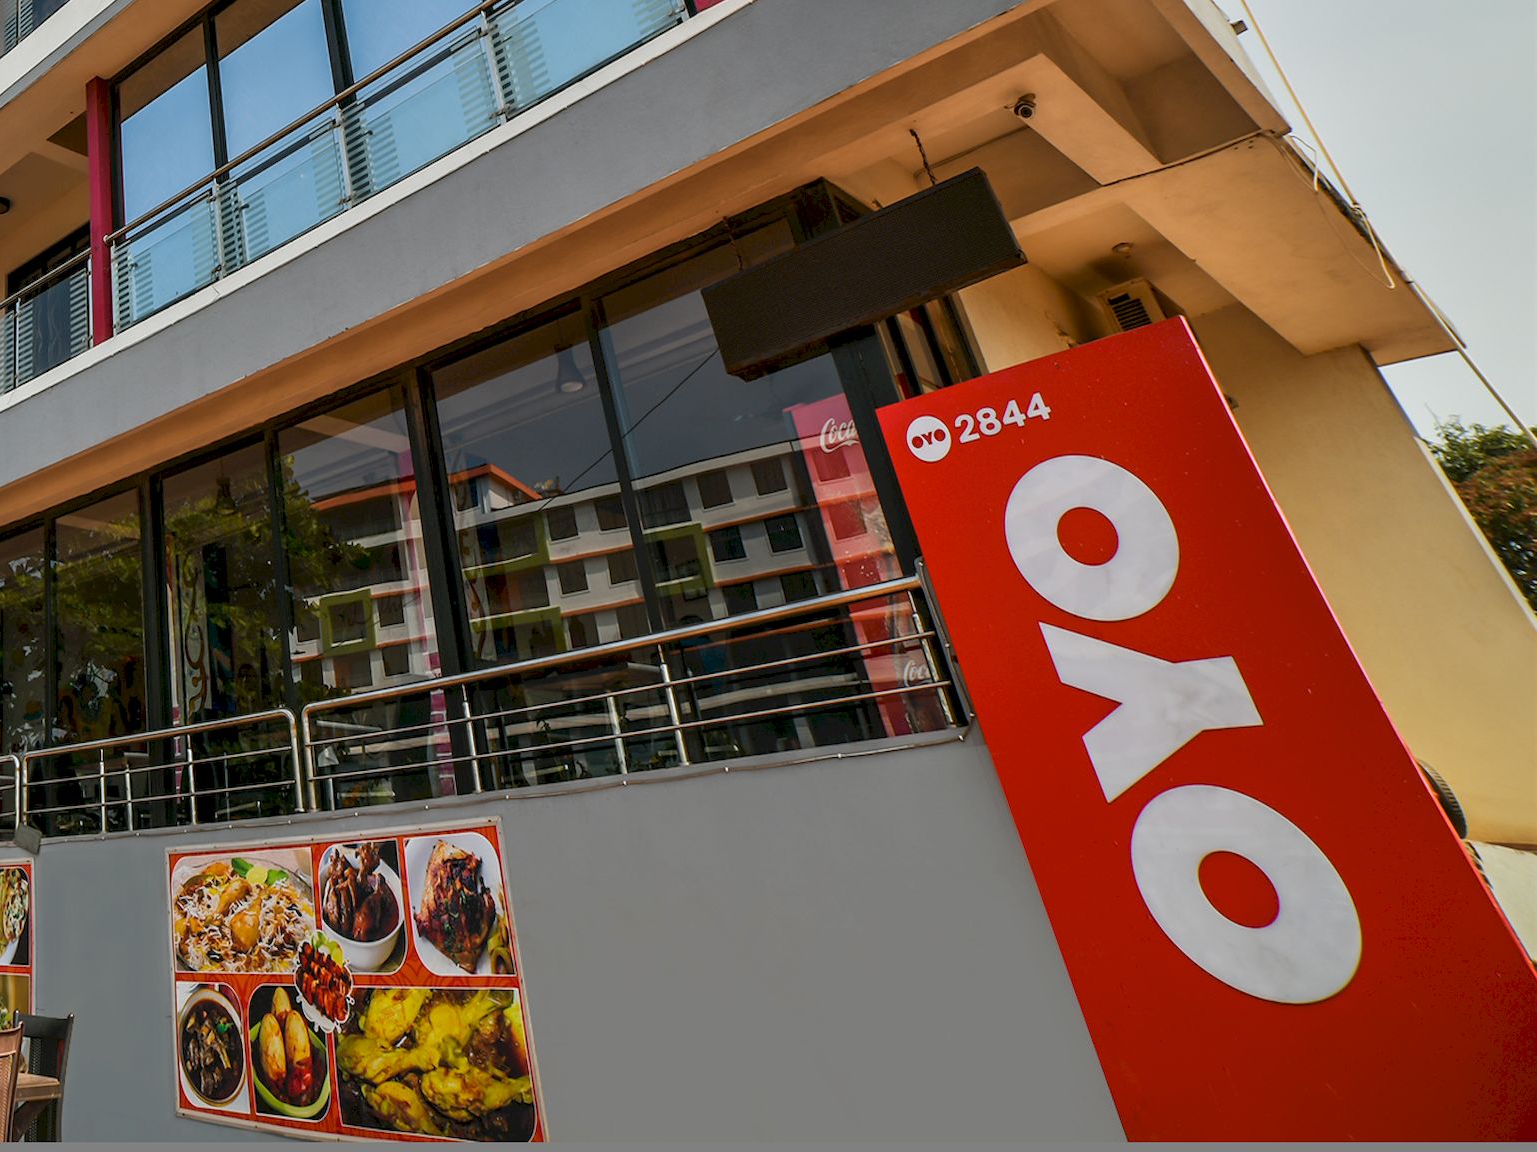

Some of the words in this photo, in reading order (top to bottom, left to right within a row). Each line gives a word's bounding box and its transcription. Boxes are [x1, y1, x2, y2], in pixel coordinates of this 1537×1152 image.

[911, 428, 946, 449] OYO
[954, 392, 1051, 444] 2844
[1004, 454, 1363, 1004] OYO
